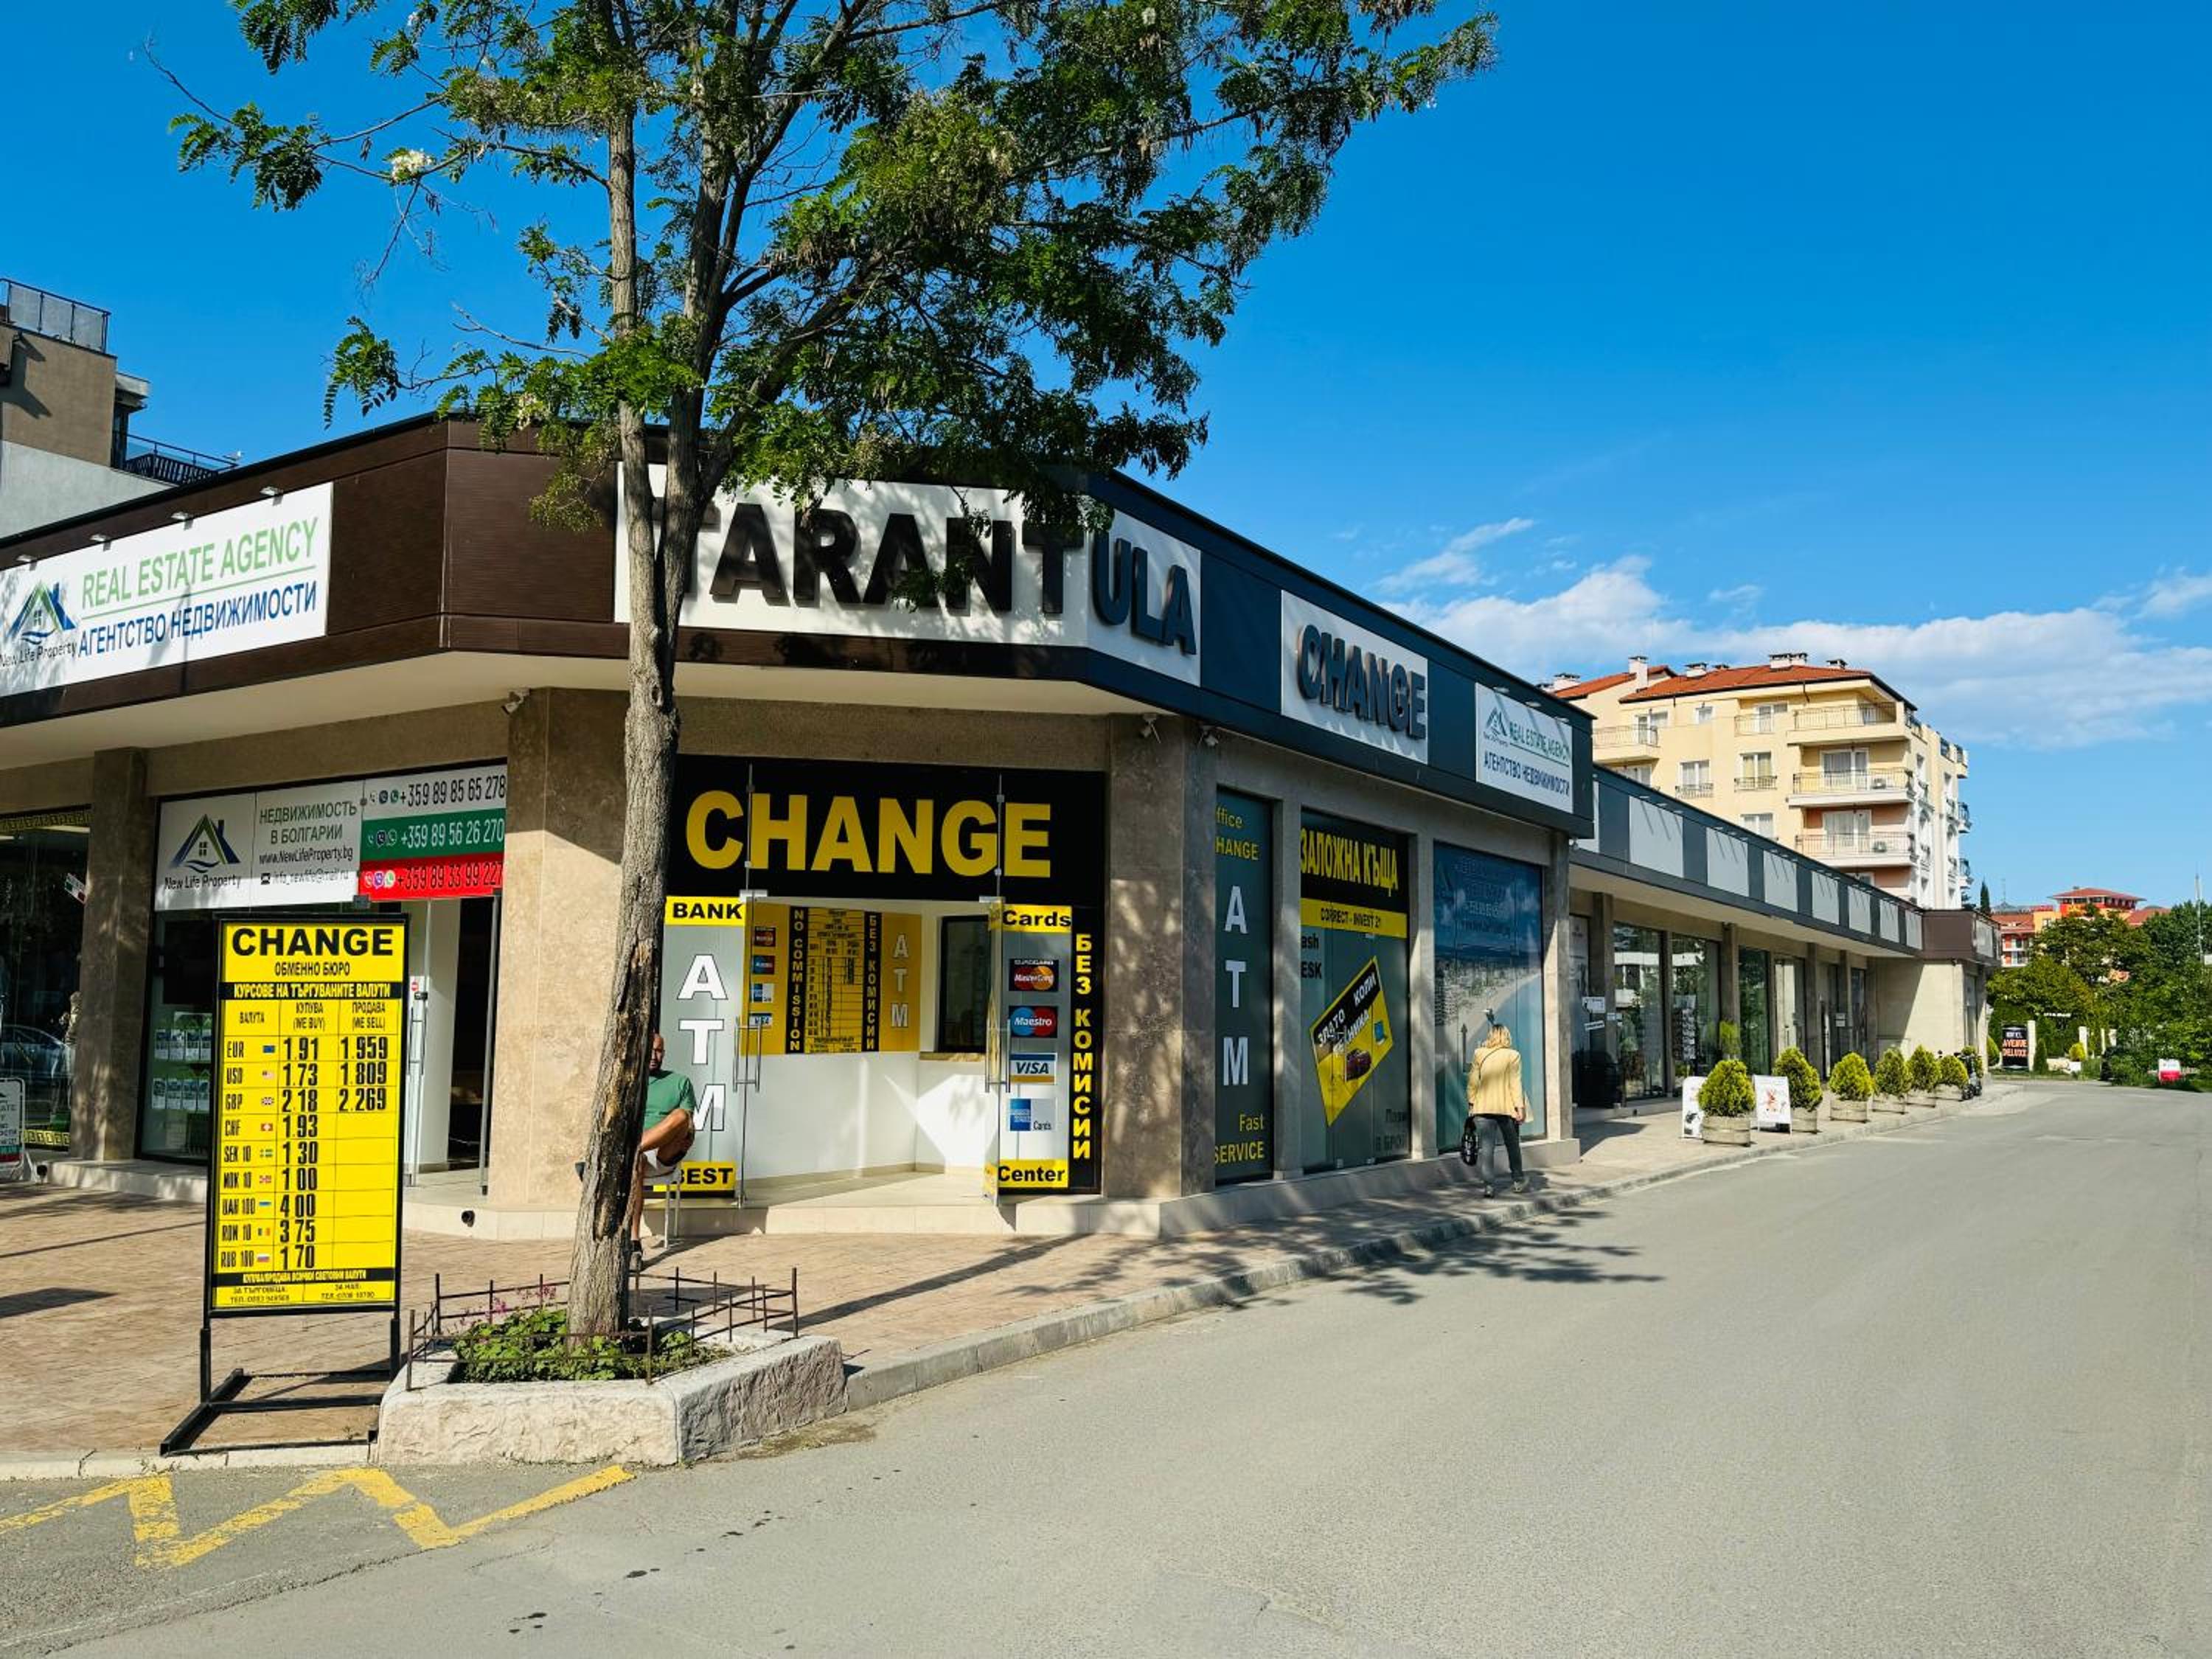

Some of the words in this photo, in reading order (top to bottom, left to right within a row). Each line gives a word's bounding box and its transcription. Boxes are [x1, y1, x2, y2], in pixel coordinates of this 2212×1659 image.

[83, 566, 131, 609] REAL
[138, 542, 215, 597] ESTATE
[220, 518, 319, 577] AGENCY
[78, 615, 166, 658] АГЕНТСТВО
[170, 580, 317, 640] НЕДВИЖИМОСТИ
[20, 648, 35, 663] Life
[37, 642, 77, 661] Property
[1298, 624, 1426, 740] CHANGE
[1509, 721, 1525, 744] REAL
[1484, 751, 1521, 779] АГЕНТСТВО
[400, 783, 430, 807] +359
[433, 781, 448, 804] 89
[451, 779, 465, 802] 85
[468, 778, 481, 801] 65
[485, 775, 507, 800] 278
[260, 801, 358, 825] НЕДВИЖИМОСТЬ
[1217, 806, 1242, 829] ffice
[271, 830, 278, 844] В
[282, 824, 343, 844] БОЛГАРИИ
[401, 825, 428, 848] +359
[431, 823, 446, 847] 89
[449, 821, 463, 845] 56
[466, 820, 480, 844] 26
[483, 818, 504, 843] 270
[686, 790, 1051, 878] CHANGE
[260, 845, 353, 864] www.NewLifeProperty.bg
[1215, 836, 1259, 860] HANGE
[1301, 827, 1361, 883] ЗАЛОЖНА
[1364, 842, 1399, 897] КЪЩА
[164, 876, 183, 889] New
[185, 874, 201, 888] Life
[202, 874, 241, 889] Property
[397, 866, 427, 890] +359
[431, 865, 445, 889] 89
[448, 863, 462, 888] 33
[465, 862, 479, 886] 99
[483, 861, 503, 886] 227
[672, 902, 742, 919] BANK
[794, 910, 804, 931] NO
[1003, 910, 1071, 928] Cards
[232, 928, 393, 956] CHANGE
[869, 915, 877, 952] БЕЗ
[1301, 933, 1319, 950] ash
[275, 961, 320, 975] ОБМЕННО
[323, 961, 350, 975] БЮРО
[1076, 933, 1092, 995] БЕЗ
[1301, 961, 1322, 979] ESK
[234, 984, 275, 998] КУРСОВЕ
[276, 984, 290, 998] НА
[291, 984, 354, 998] ТЪРГУВАНИТЕ
[356, 984, 390, 998] ВАЛУТИ
[790, 939, 804, 1051] COMMISSION
[1222, 885, 1249, 1086] ATM
[866, 961, 877, 1050] КОМИСИИ
[1014, 1017, 1053, 1026] Maestro
[227, 1041, 244, 1058] EUR
[283, 1037, 319, 1060] 1.91
[341, 1037, 388, 1060] 1.959
[226, 1068, 243, 1084] USD
[282, 1062, 318, 1086] 1.73
[340, 1062, 387, 1085] 1.809
[1015, 1062, 1050, 1074] VISA
[1073, 1009, 1093, 1161] КОМИСИИ
[225, 1093, 243, 1110] GBP
[282, 1089, 318, 1113] 2.18
[338, 1088, 386, 1111] 2.269
[282, 1115, 318, 1138] 1.93
[1239, 1113, 1263, 1132] Fast
[243, 1145, 251, 1162] 10
[998, 1166, 1065, 1183] Center
